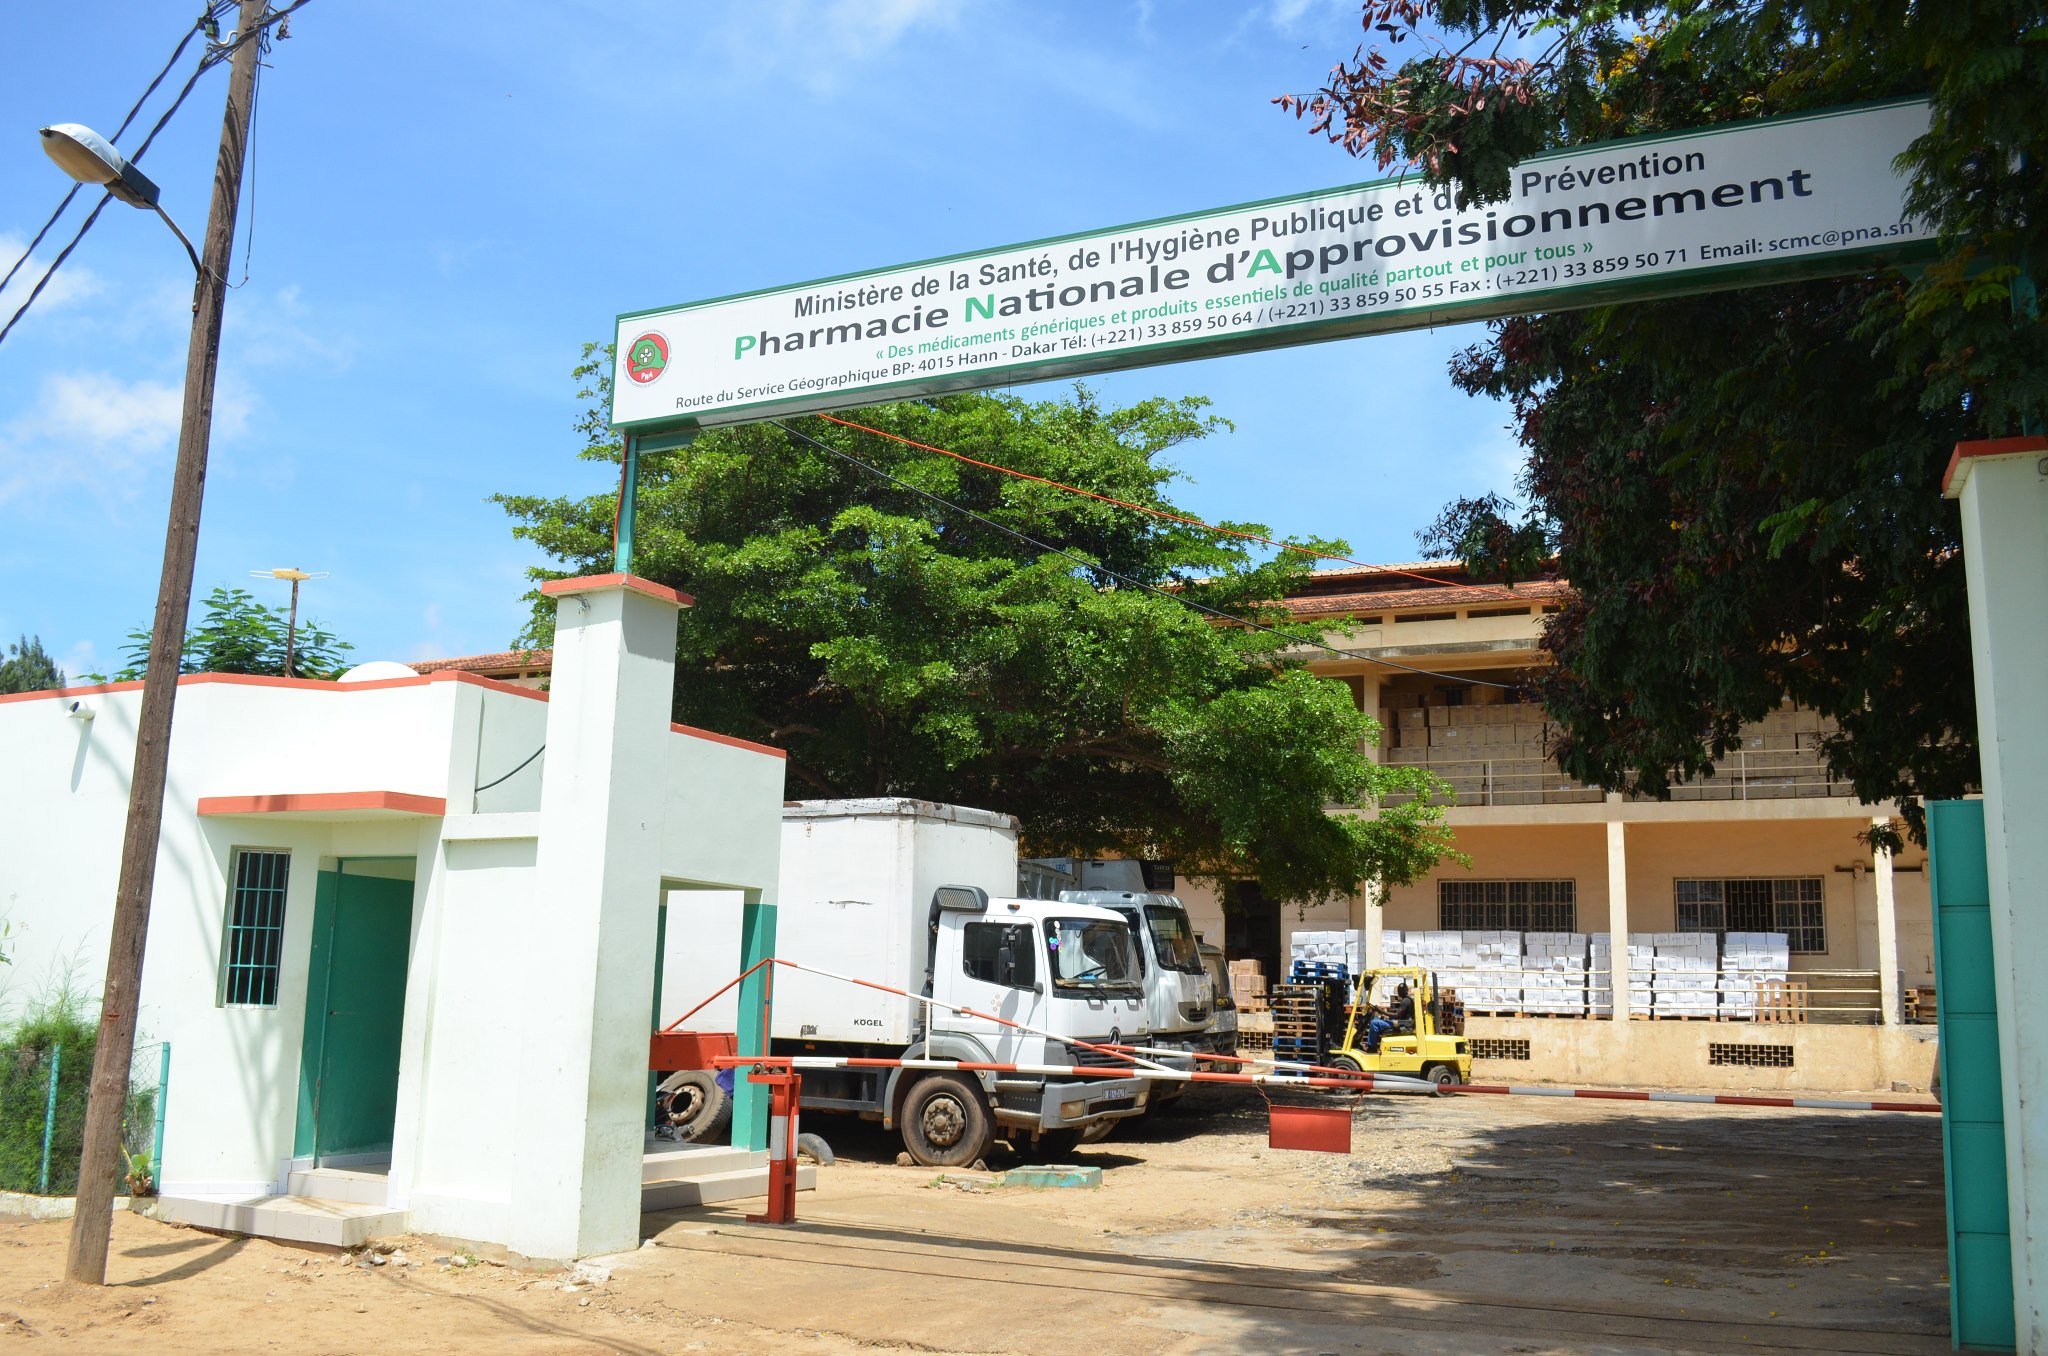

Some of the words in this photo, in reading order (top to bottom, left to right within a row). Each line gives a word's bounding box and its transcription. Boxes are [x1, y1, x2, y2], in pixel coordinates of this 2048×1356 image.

[795, 285, 903, 318] Ministère
[912, 276, 939, 297] de
[950, 271, 969, 291] la
[979, 254, 1057, 285] Santé,
[1069, 248, 1100, 270] de
[1111, 228, 1239, 264] l'Hygiène
[1252, 204, 1383, 241] Publique
[1395, 191, 1423, 217] et
[1522, 152, 1704, 197] Prévention
[888, 345, 913, 358] Des
[919, 328, 1015, 353] médicaments
[1021, 316, 1105, 341] génériques
[1111, 310, 1127, 324] et
[1132, 300, 1197, 324] produits
[1205, 285, 1287, 310] essentiels
[1293, 281, 1313, 297] de
[1319, 269, 1379, 296] qualité
[1386, 261, 1452, 287] partout
[1461, 257, 1479, 272] et
[1485, 251, 1527, 272] pour
[1534, 245, 1575, 261] tous
[676, 395, 713, 408] Route
[717, 390, 733, 402] du
[737, 383, 784, 399] Service
[789, 369, 888, 390] Géographique
[893, 362, 914, 376] BP:
[918, 356, 953, 371] 4015
[959, 352, 997, 365] Hann
[1012, 342, 1057, 357] Dakar
[1060, 335, 1086, 350] Tél:
[1092, 327, 1142, 348] (+221)
[1148, 324, 1166, 337] 33
[1172, 319, 1202, 334] 859
[1207, 315, 1227, 329] 50
[1232, 311, 1252, 325] 64
[1269, 300, 1324, 322] (+221)
[1330, 297, 1350, 311] 33
[1356, 291, 1389, 307] 859
[1395, 287, 1416, 302] 50
[1422, 283, 1443, 298] 55
[1450, 280, 1481, 294] Fax
[1497, 266, 1557, 289] (+221)
[1564, 262, 1586, 278] 33
[1593, 256, 1629, 273] 859
[1635, 253, 1659, 268] 50
[1665, 249, 1686, 264] 71
[1700, 238, 1762, 260] Email:
[1769, 222, 1913, 251] scmc@pna.sn
[735, 305, 948, 360] Pharmacie
[965, 265, 1189, 322] Nationale
